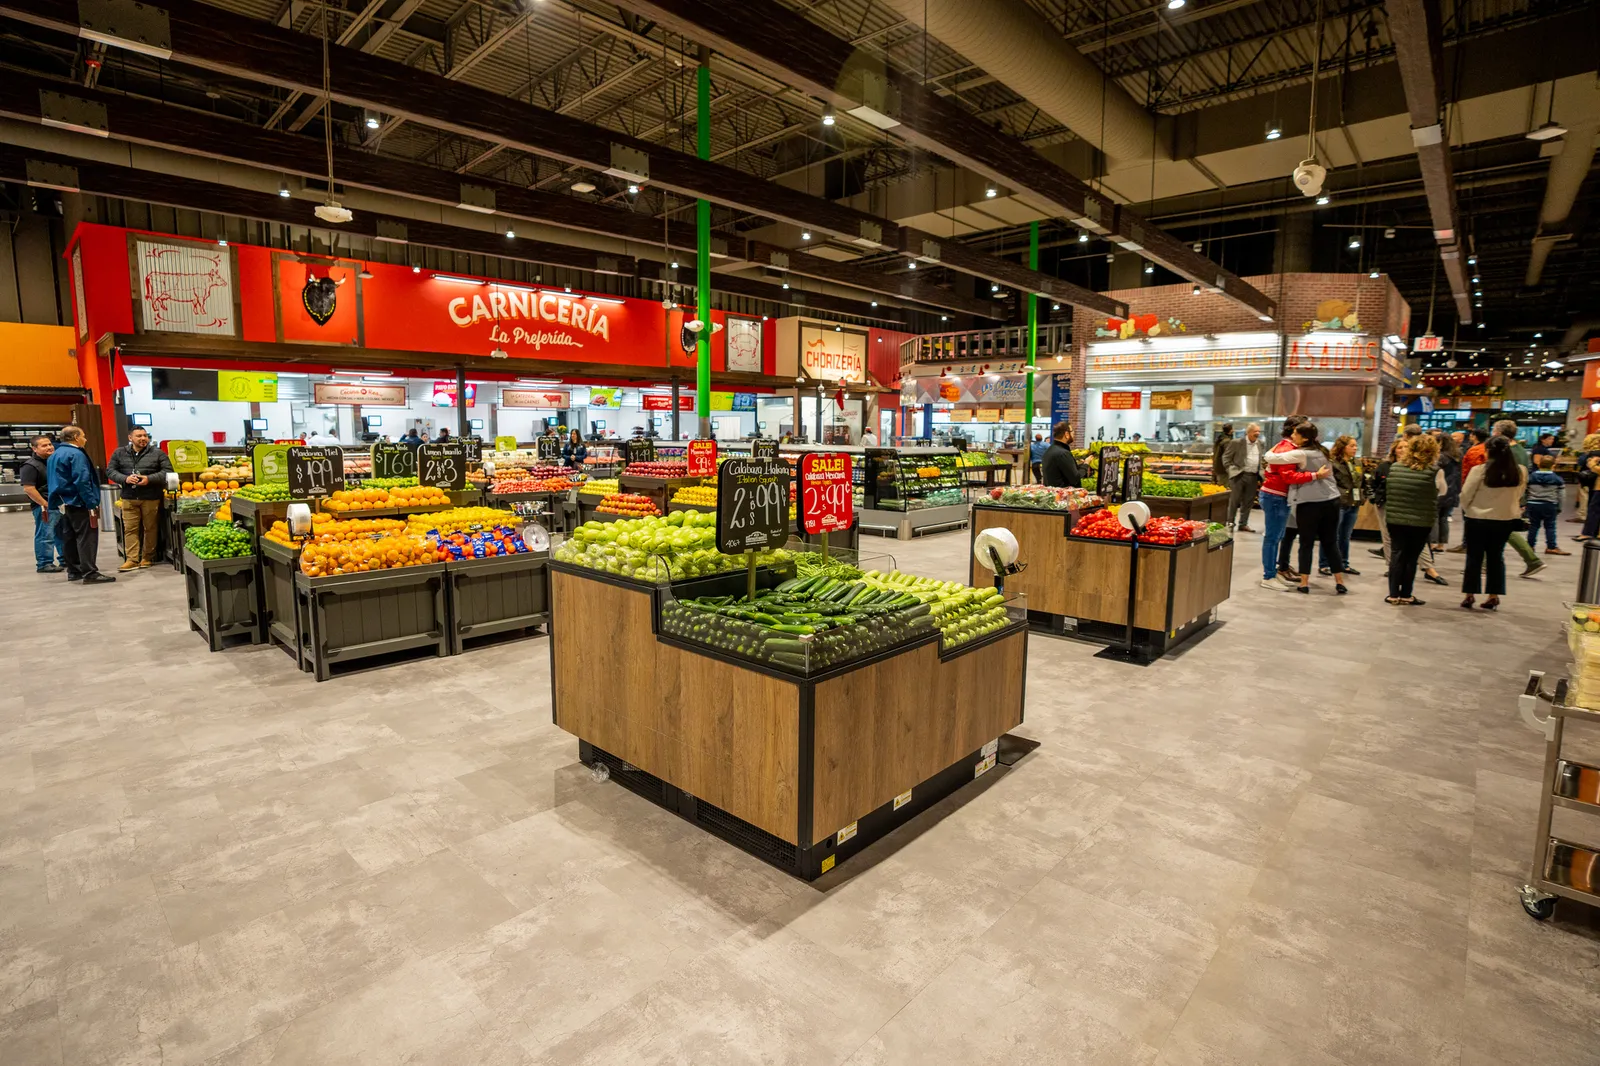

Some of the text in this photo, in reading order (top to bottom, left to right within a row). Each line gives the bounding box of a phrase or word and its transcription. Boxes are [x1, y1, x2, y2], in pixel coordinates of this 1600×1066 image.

[448, 291, 609, 342] CARNICERÍA
[489, 324, 510, 343] La
[1418, 338, 1438, 349] EXIT
[806, 351, 862, 372] CHORIZERÍA
[1093, 348, 1272, 371] ASADOS LOS MESQUITES
[1289, 341, 1377, 372] ASADOS
[981, 379, 1027, 394] LAS CAZUELA
[175, 448, 187, 461] 5
[262, 455, 278, 474] 5
[728, 461, 762, 475] Calabaza
[811, 458, 844, 472] SALE!
[736, 475, 758, 484] Italian
[729, 488, 746, 529] 2
[804, 487, 821, 515] 2
